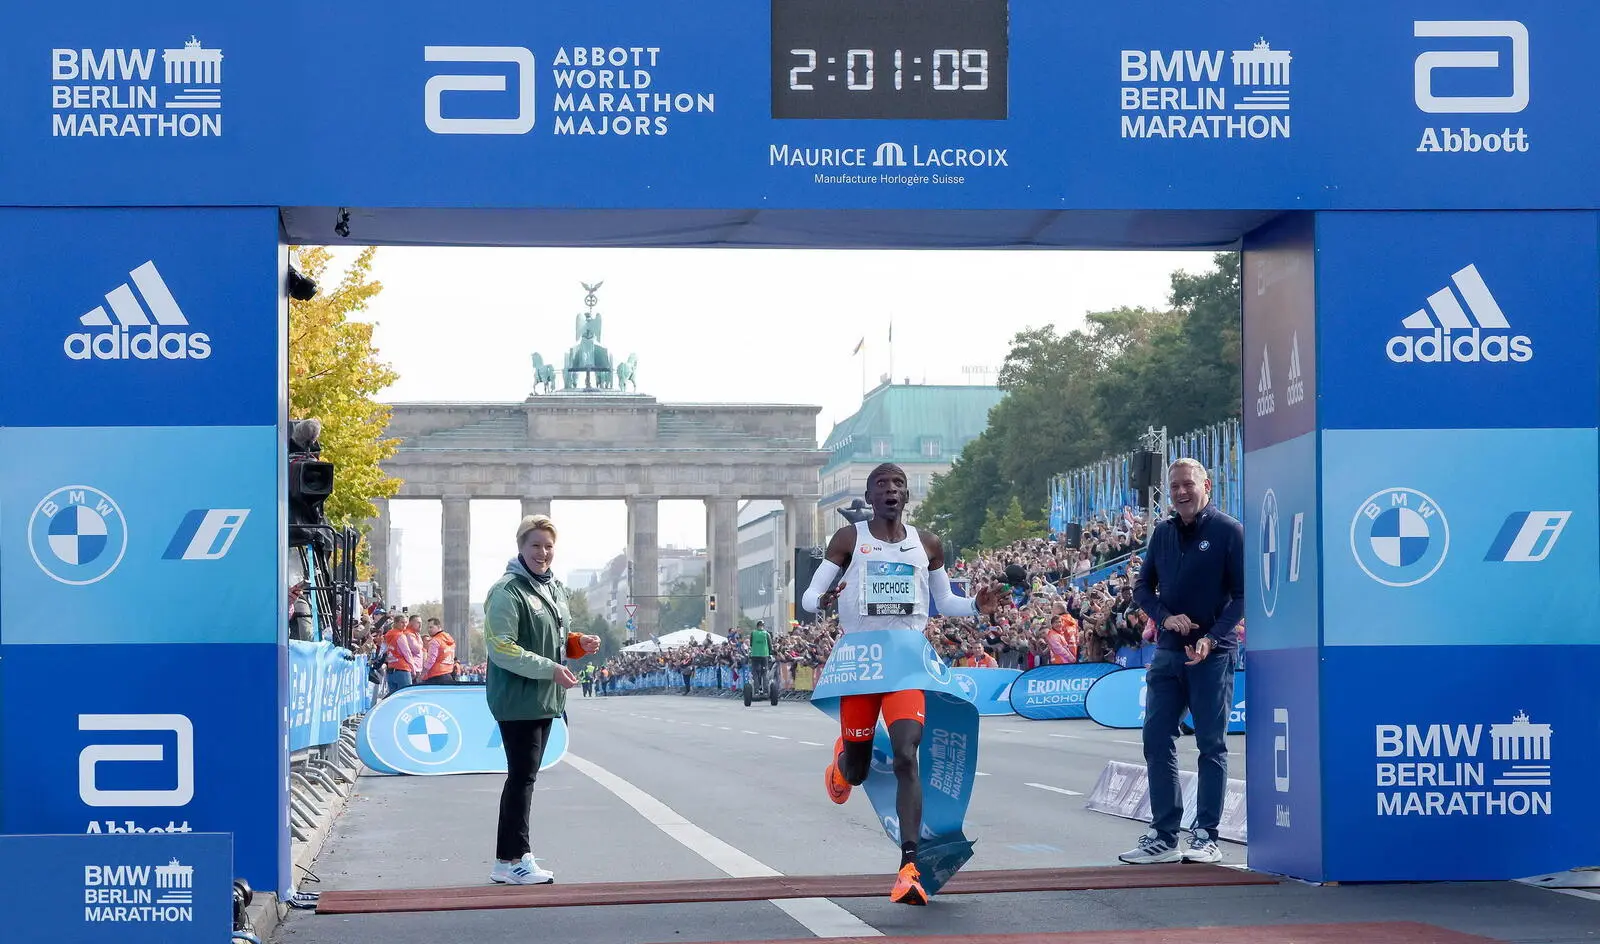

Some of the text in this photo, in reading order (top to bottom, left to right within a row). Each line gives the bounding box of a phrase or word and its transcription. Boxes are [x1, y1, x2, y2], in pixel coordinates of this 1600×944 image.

[52, 48, 155, 81] BMW
[552, 46, 661, 67] ABBOTT
[1121, 50, 1225, 82] BMW
[552, 69, 651, 89] WORLD
[789, 49, 989, 91] 2:01:09
[52, 86, 157, 109] BERLIN
[553, 93, 714, 113] MARATHON
[1121, 87, 1225, 110] BERLIN
[52, 113, 222, 137] MARATHON
[553, 115, 669, 136] MAJORS
[1121, 115, 1290, 139] MARATHON
[1416, 127, 1530, 153] Abbott
[769, 144, 1009, 167] MAURICE LACROIX
[814, 173, 965, 187] Manufacture Horlogère Suisse
[64, 325, 212, 360] adidas
[1386, 328, 1533, 363] adidas
[42, 490, 114, 517] BMW
[1363, 493, 1436, 519] BMW
[872, 582, 910, 594] KIPCHOGE
[857, 643, 883, 662] 20
[858, 662, 884, 681] 22
[400, 705, 450, 724] BMW
[1375, 723, 1483, 758] BMW
[930, 757, 945, 791] BMW
[942, 760, 956, 795] BERLIN
[950, 749, 967, 800] MARATHON
[1376, 762, 1484, 787] BERLIN
[1376, 790, 1552, 816] MARATHON
[84, 865, 151, 886] BMW
[84, 888, 152, 904] BERLIN
[84, 906, 193, 922] MARATHON
